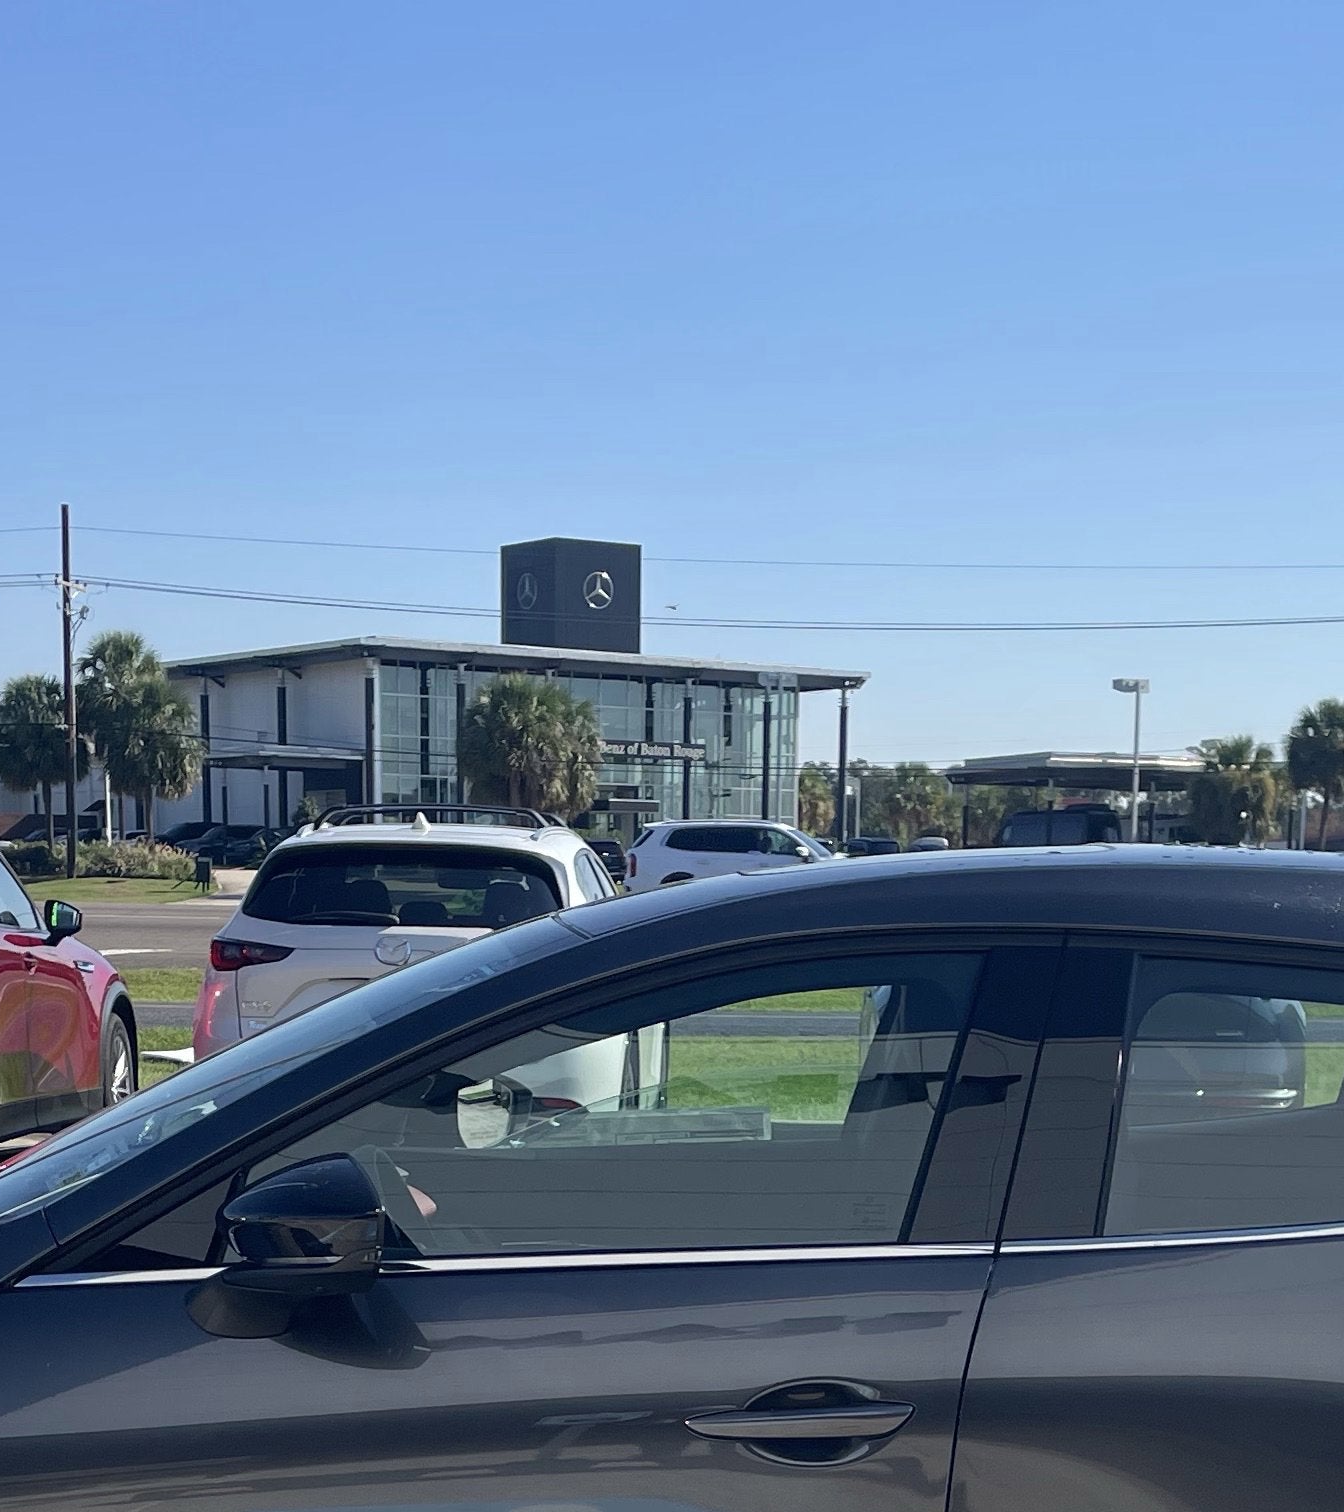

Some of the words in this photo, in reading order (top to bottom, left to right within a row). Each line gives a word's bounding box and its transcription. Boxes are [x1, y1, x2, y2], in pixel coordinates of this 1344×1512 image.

[627, 743, 639, 755] of
[641, 743, 670, 756] Baton
[673, 745, 705, 760] Rouge
